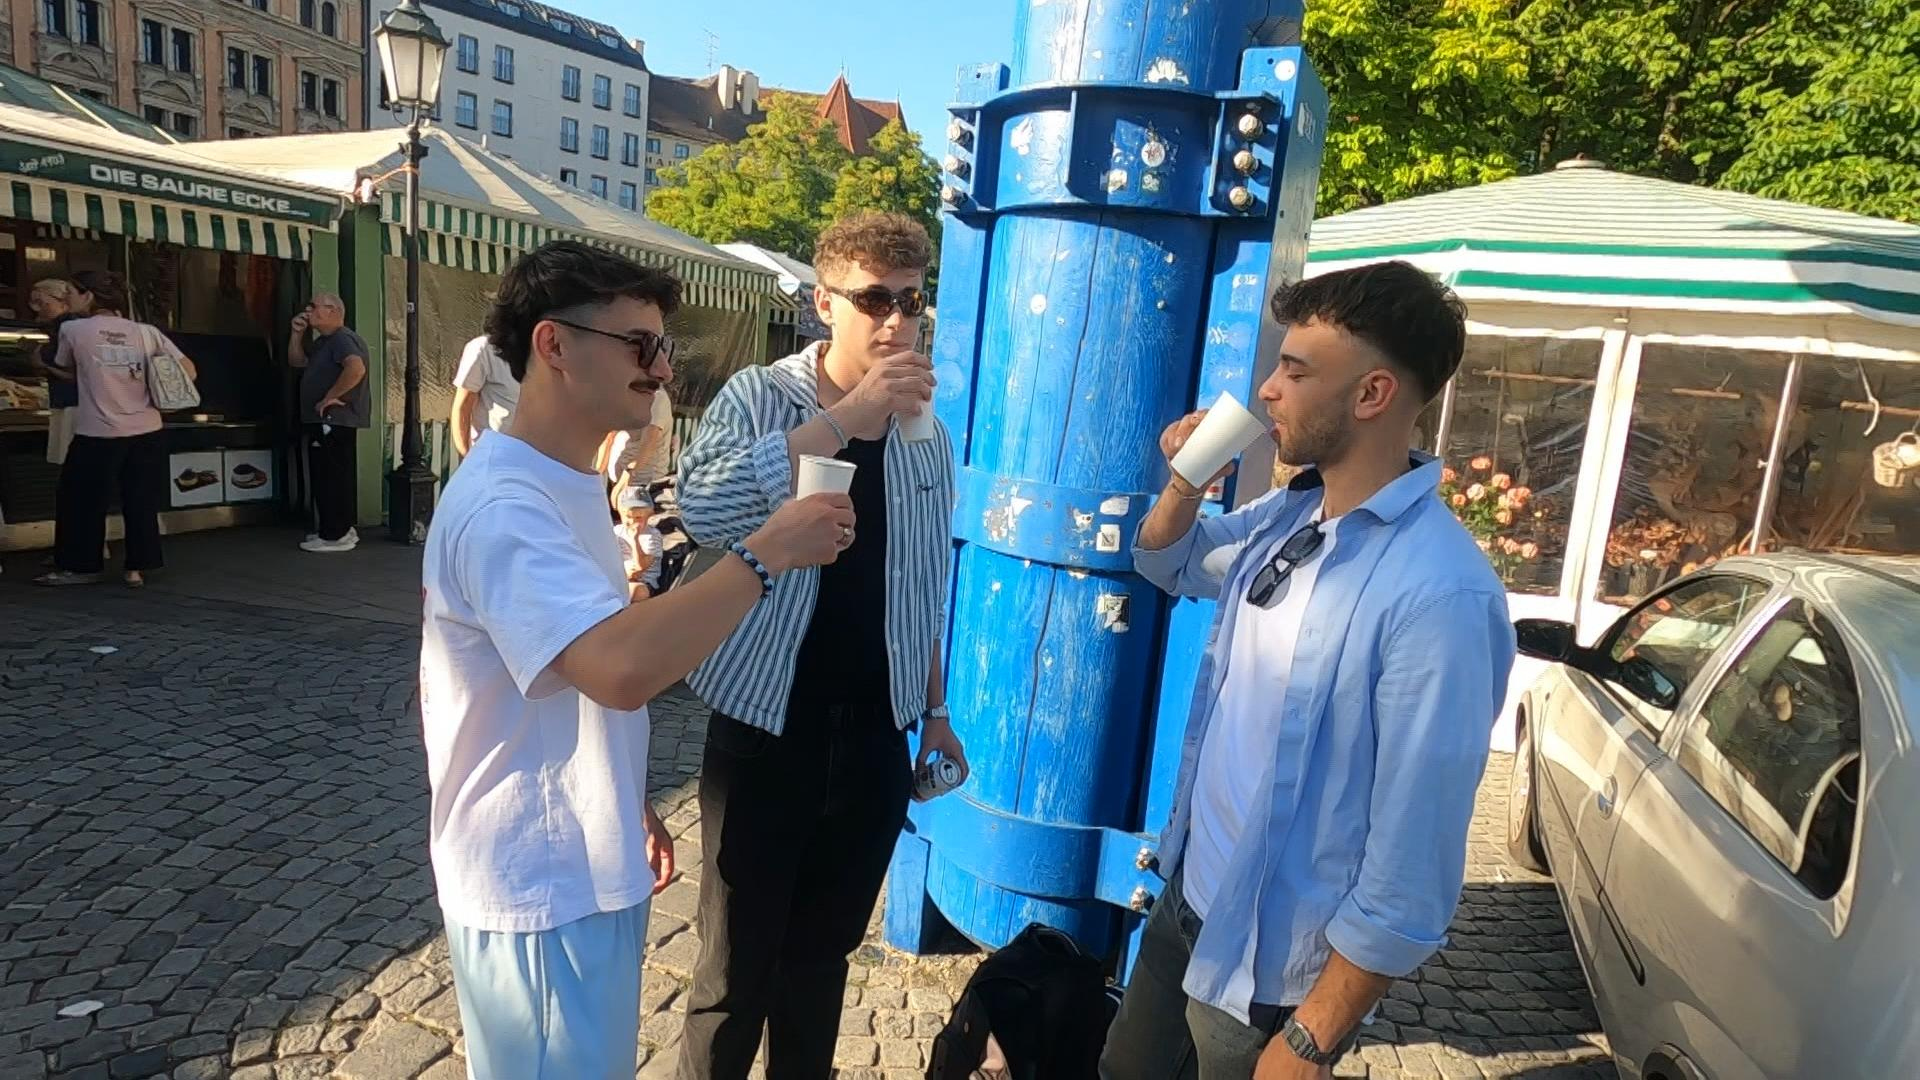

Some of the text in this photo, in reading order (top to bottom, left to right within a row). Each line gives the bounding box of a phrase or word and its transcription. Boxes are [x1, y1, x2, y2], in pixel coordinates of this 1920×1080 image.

[89, 164, 291, 213] DIE SAURE ECKE
